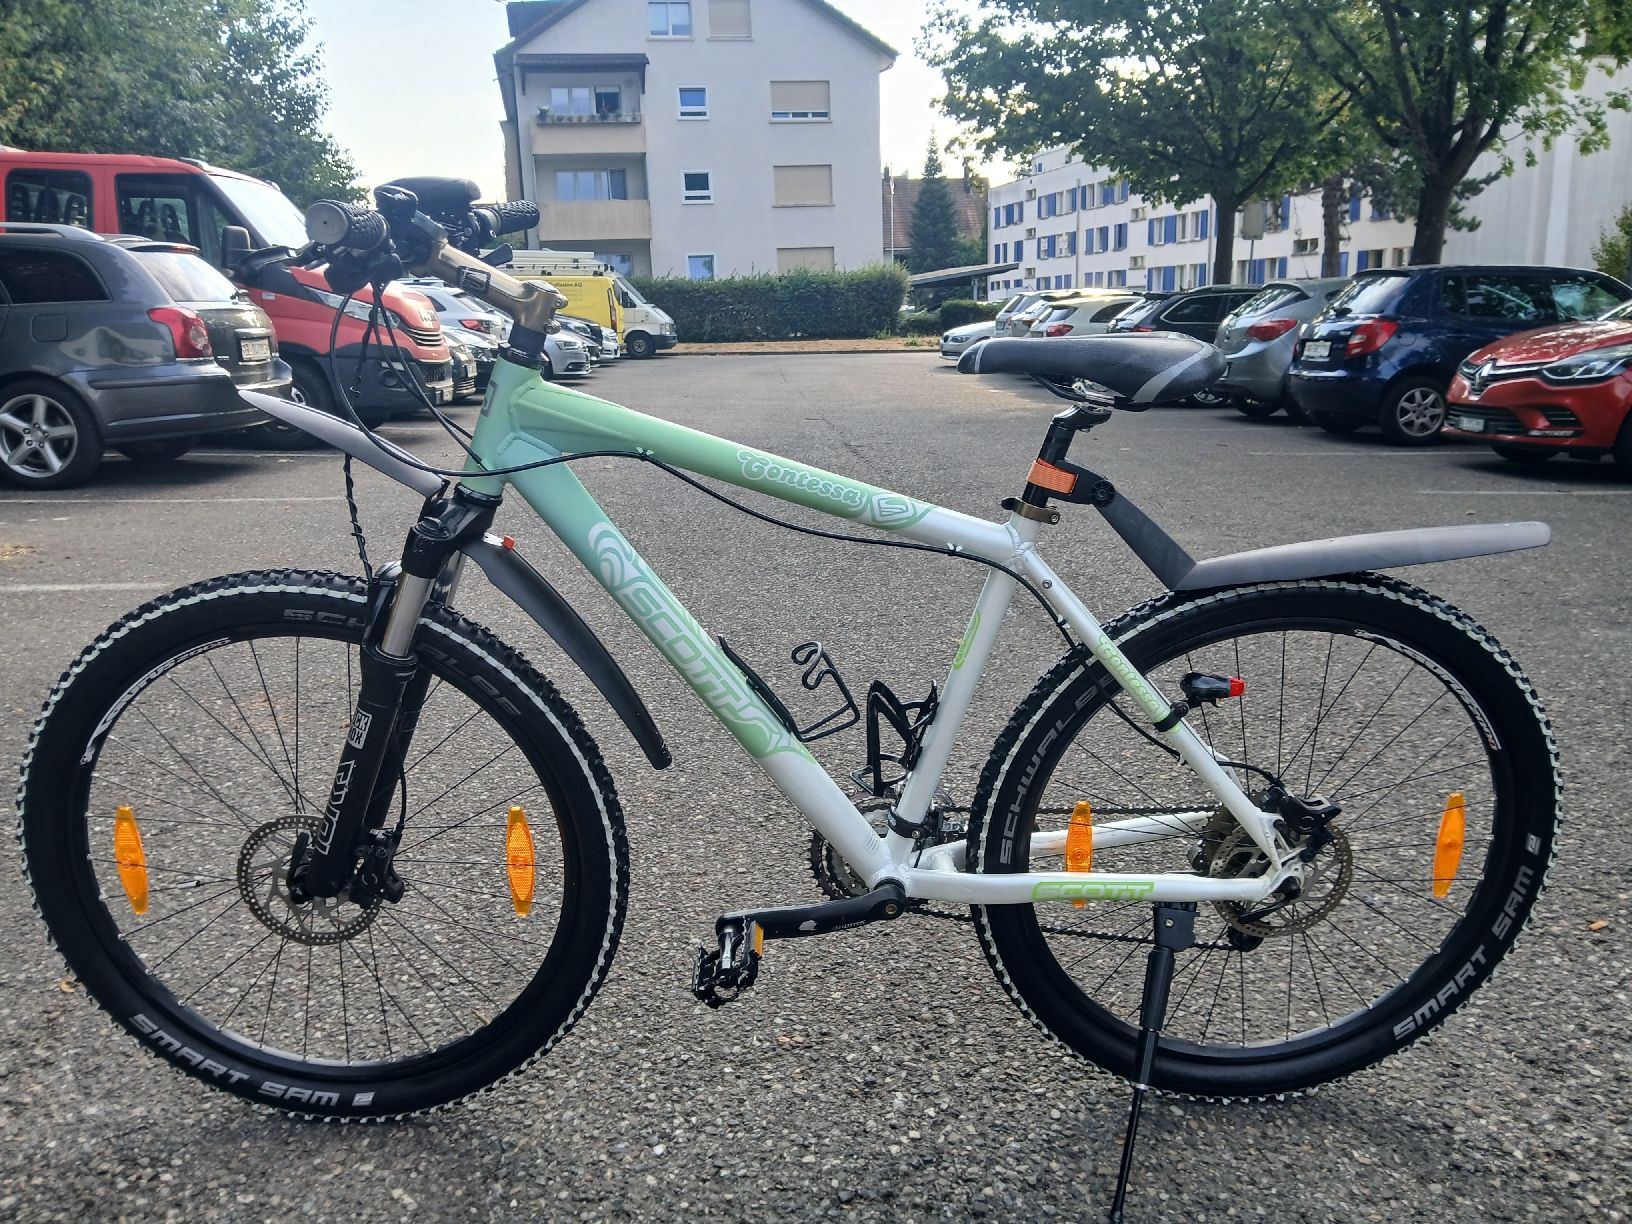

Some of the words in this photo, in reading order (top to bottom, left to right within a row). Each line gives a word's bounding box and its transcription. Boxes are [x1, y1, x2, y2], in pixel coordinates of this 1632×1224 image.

[737, 450, 865, 506] Contessa
[622, 585, 741, 712] SCOTT
[1000, 672, 1115, 866] SCHWALBE
[1036, 883, 1151, 900] SCOTT
[1393, 943, 1488, 1041] SMART
[1491, 865, 1535, 940] SAM
[129, 1013, 250, 1084] SMART
[258, 1081, 341, 1108] SAM
